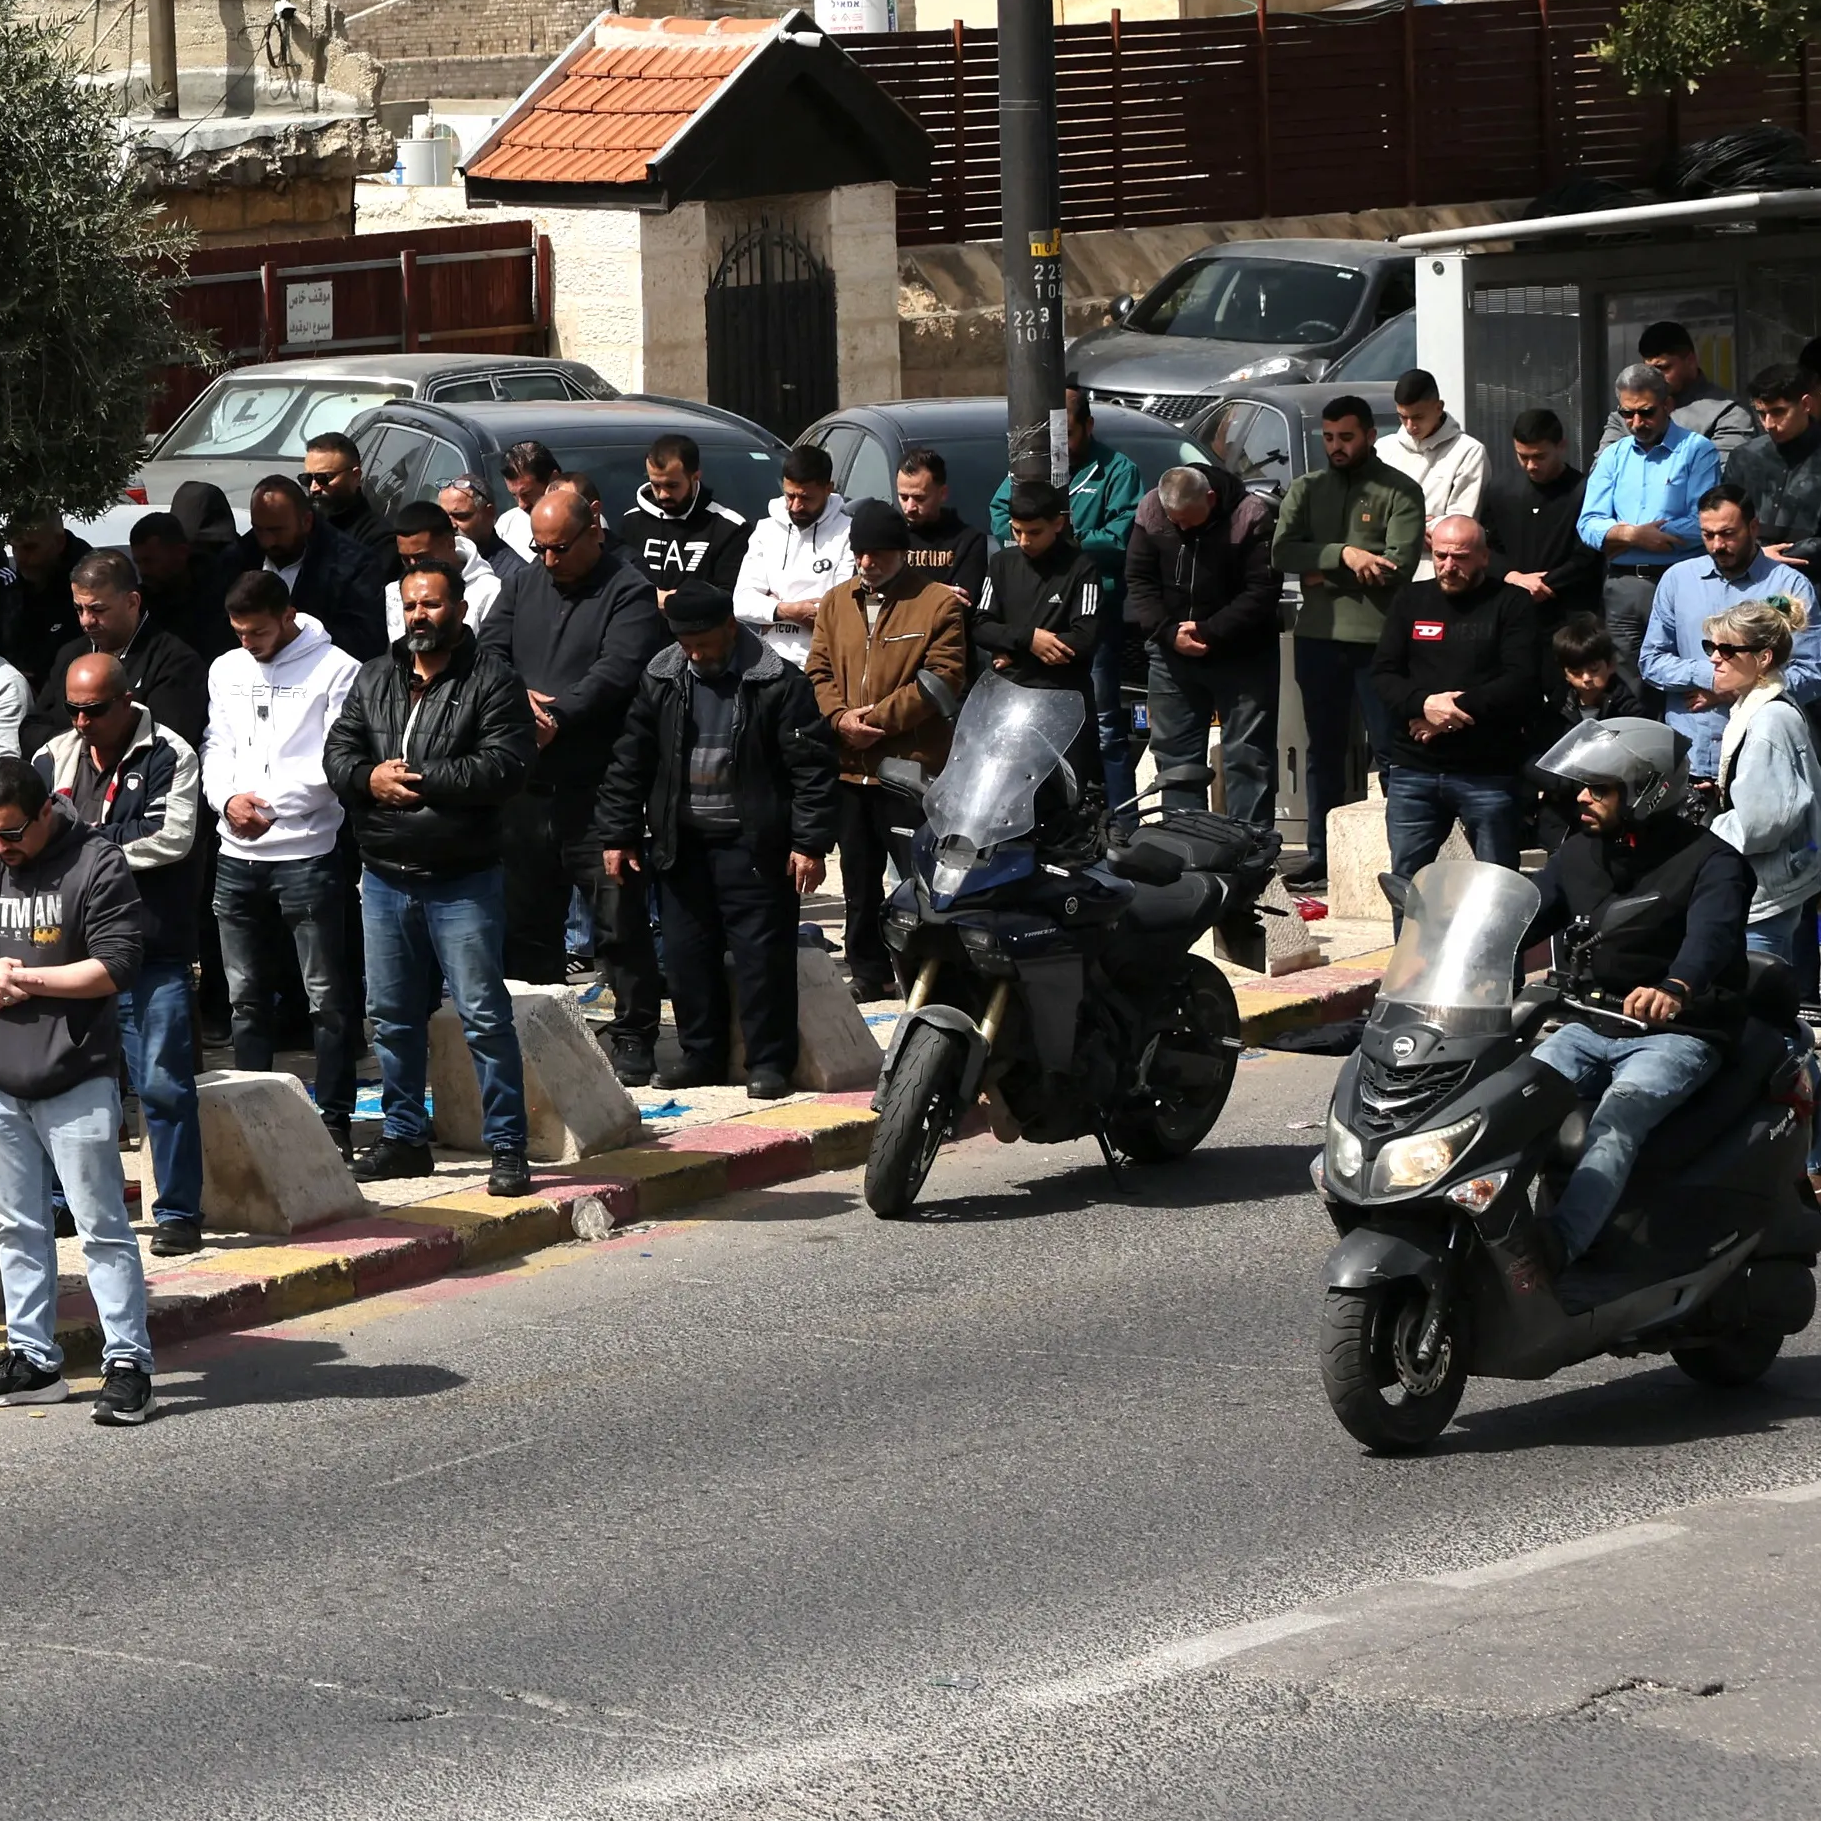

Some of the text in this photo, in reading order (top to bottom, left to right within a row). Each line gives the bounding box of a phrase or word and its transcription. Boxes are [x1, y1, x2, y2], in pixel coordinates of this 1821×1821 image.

[830, 0, 861, 8] אמאיל
[1013, 307, 1050, 328] 223
[643, 538, 710, 572] EA7
[775, 623, 800, 634] ICON
[1137, 711, 1145, 721] IL
